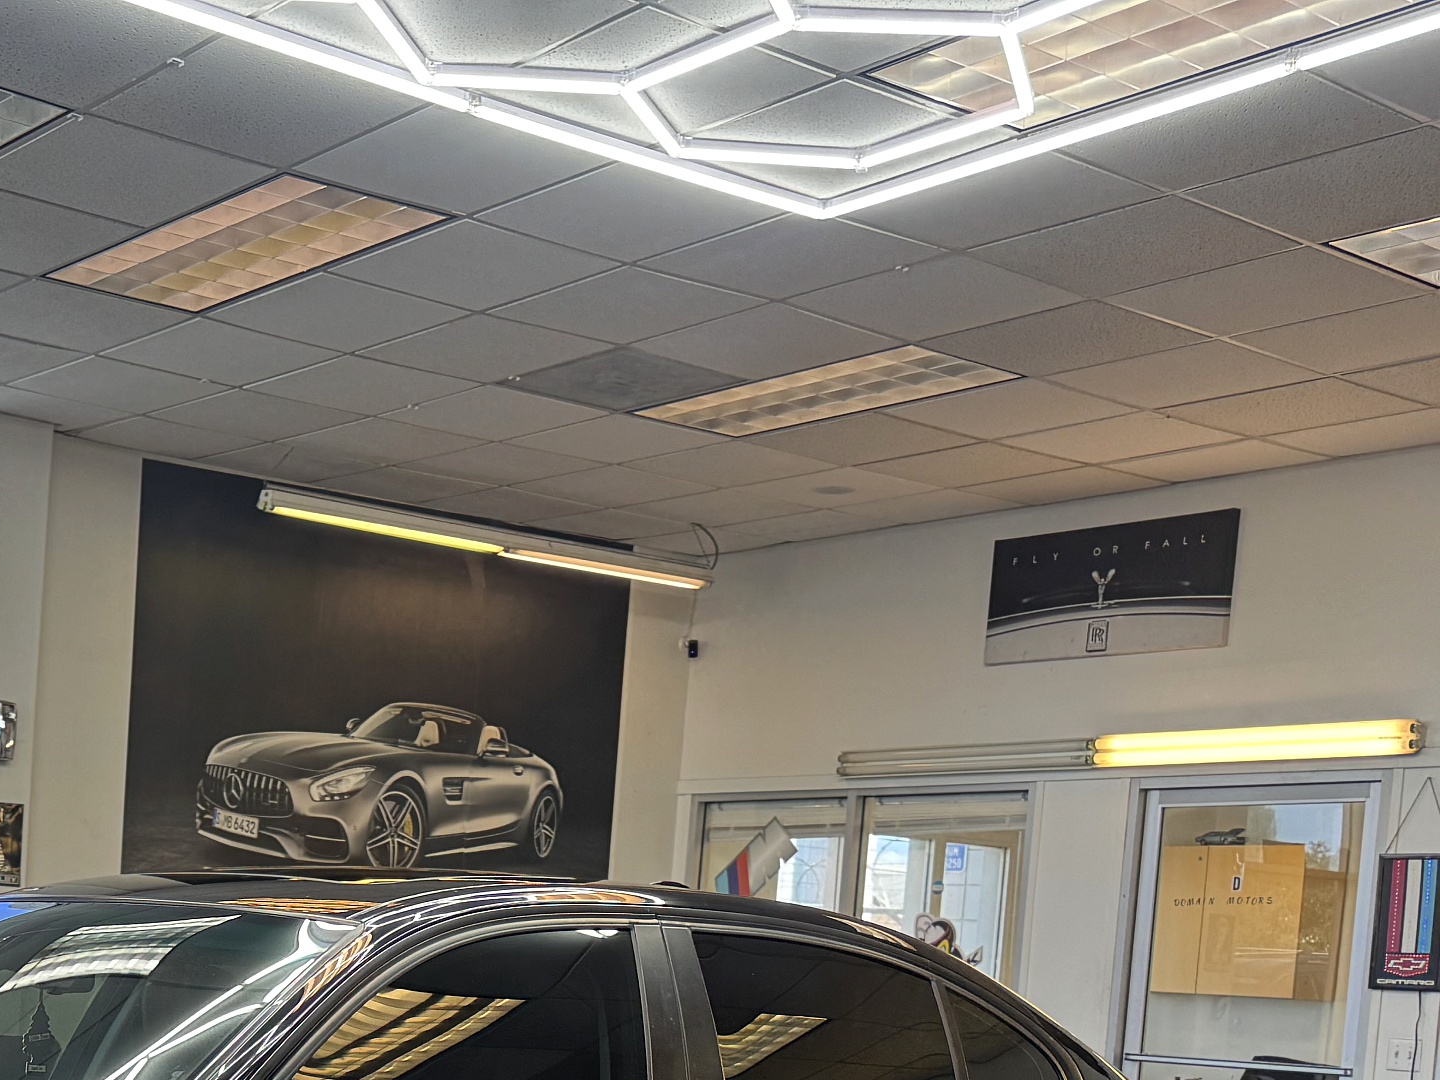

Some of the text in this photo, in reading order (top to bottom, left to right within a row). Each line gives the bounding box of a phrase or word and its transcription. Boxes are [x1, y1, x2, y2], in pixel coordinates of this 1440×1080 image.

[1012, 534, 1207, 566] FLY OR FALL
[234, 817, 256, 835] 6432
[1173, 896, 1273, 907] DOMAIN MOTORS
[1376, 978, 1435, 986] CAMARO
